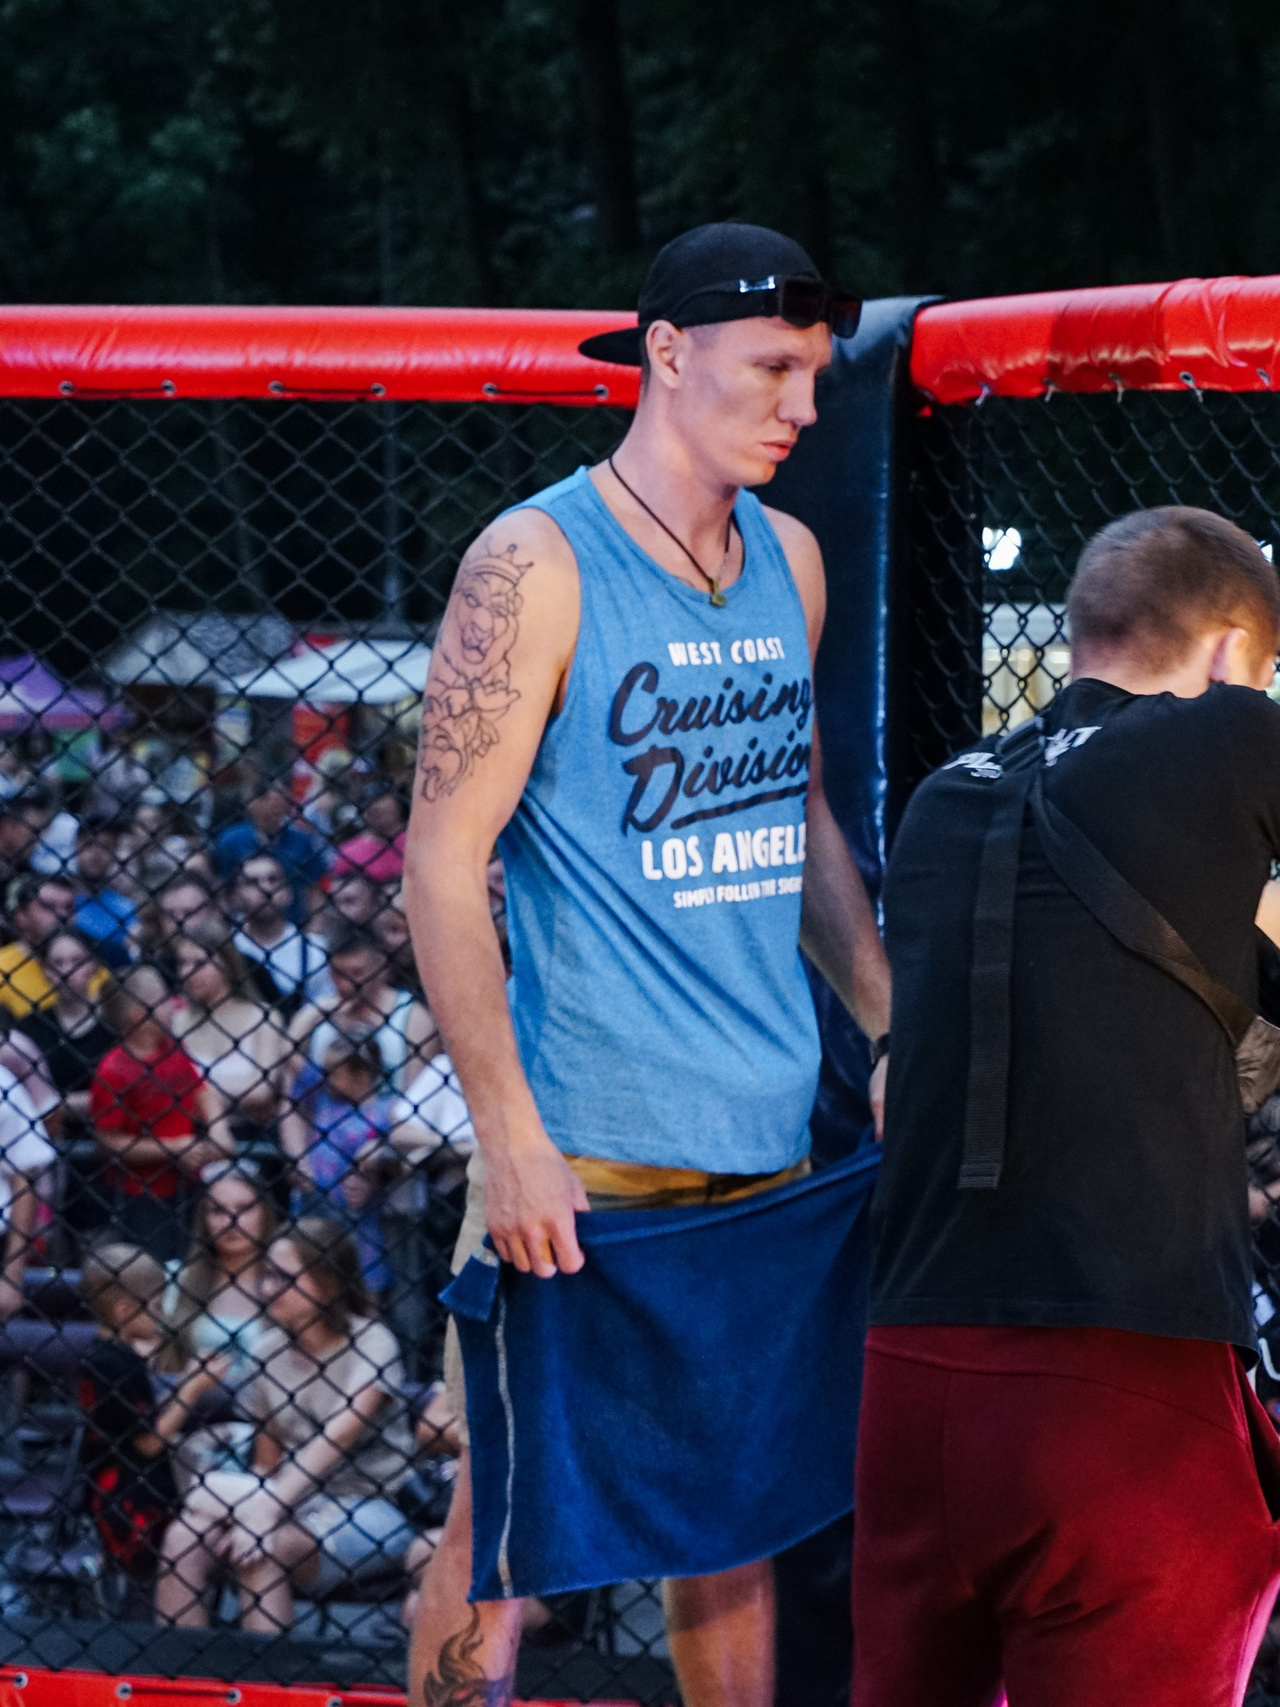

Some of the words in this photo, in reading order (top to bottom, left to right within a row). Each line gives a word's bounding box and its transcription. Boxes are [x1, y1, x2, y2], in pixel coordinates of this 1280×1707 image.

[667, 641, 722, 666] WEST
[730, 637, 785, 664] COAST
[608, 661, 811, 746] Cruising
[641, 834, 704, 881] LOS
